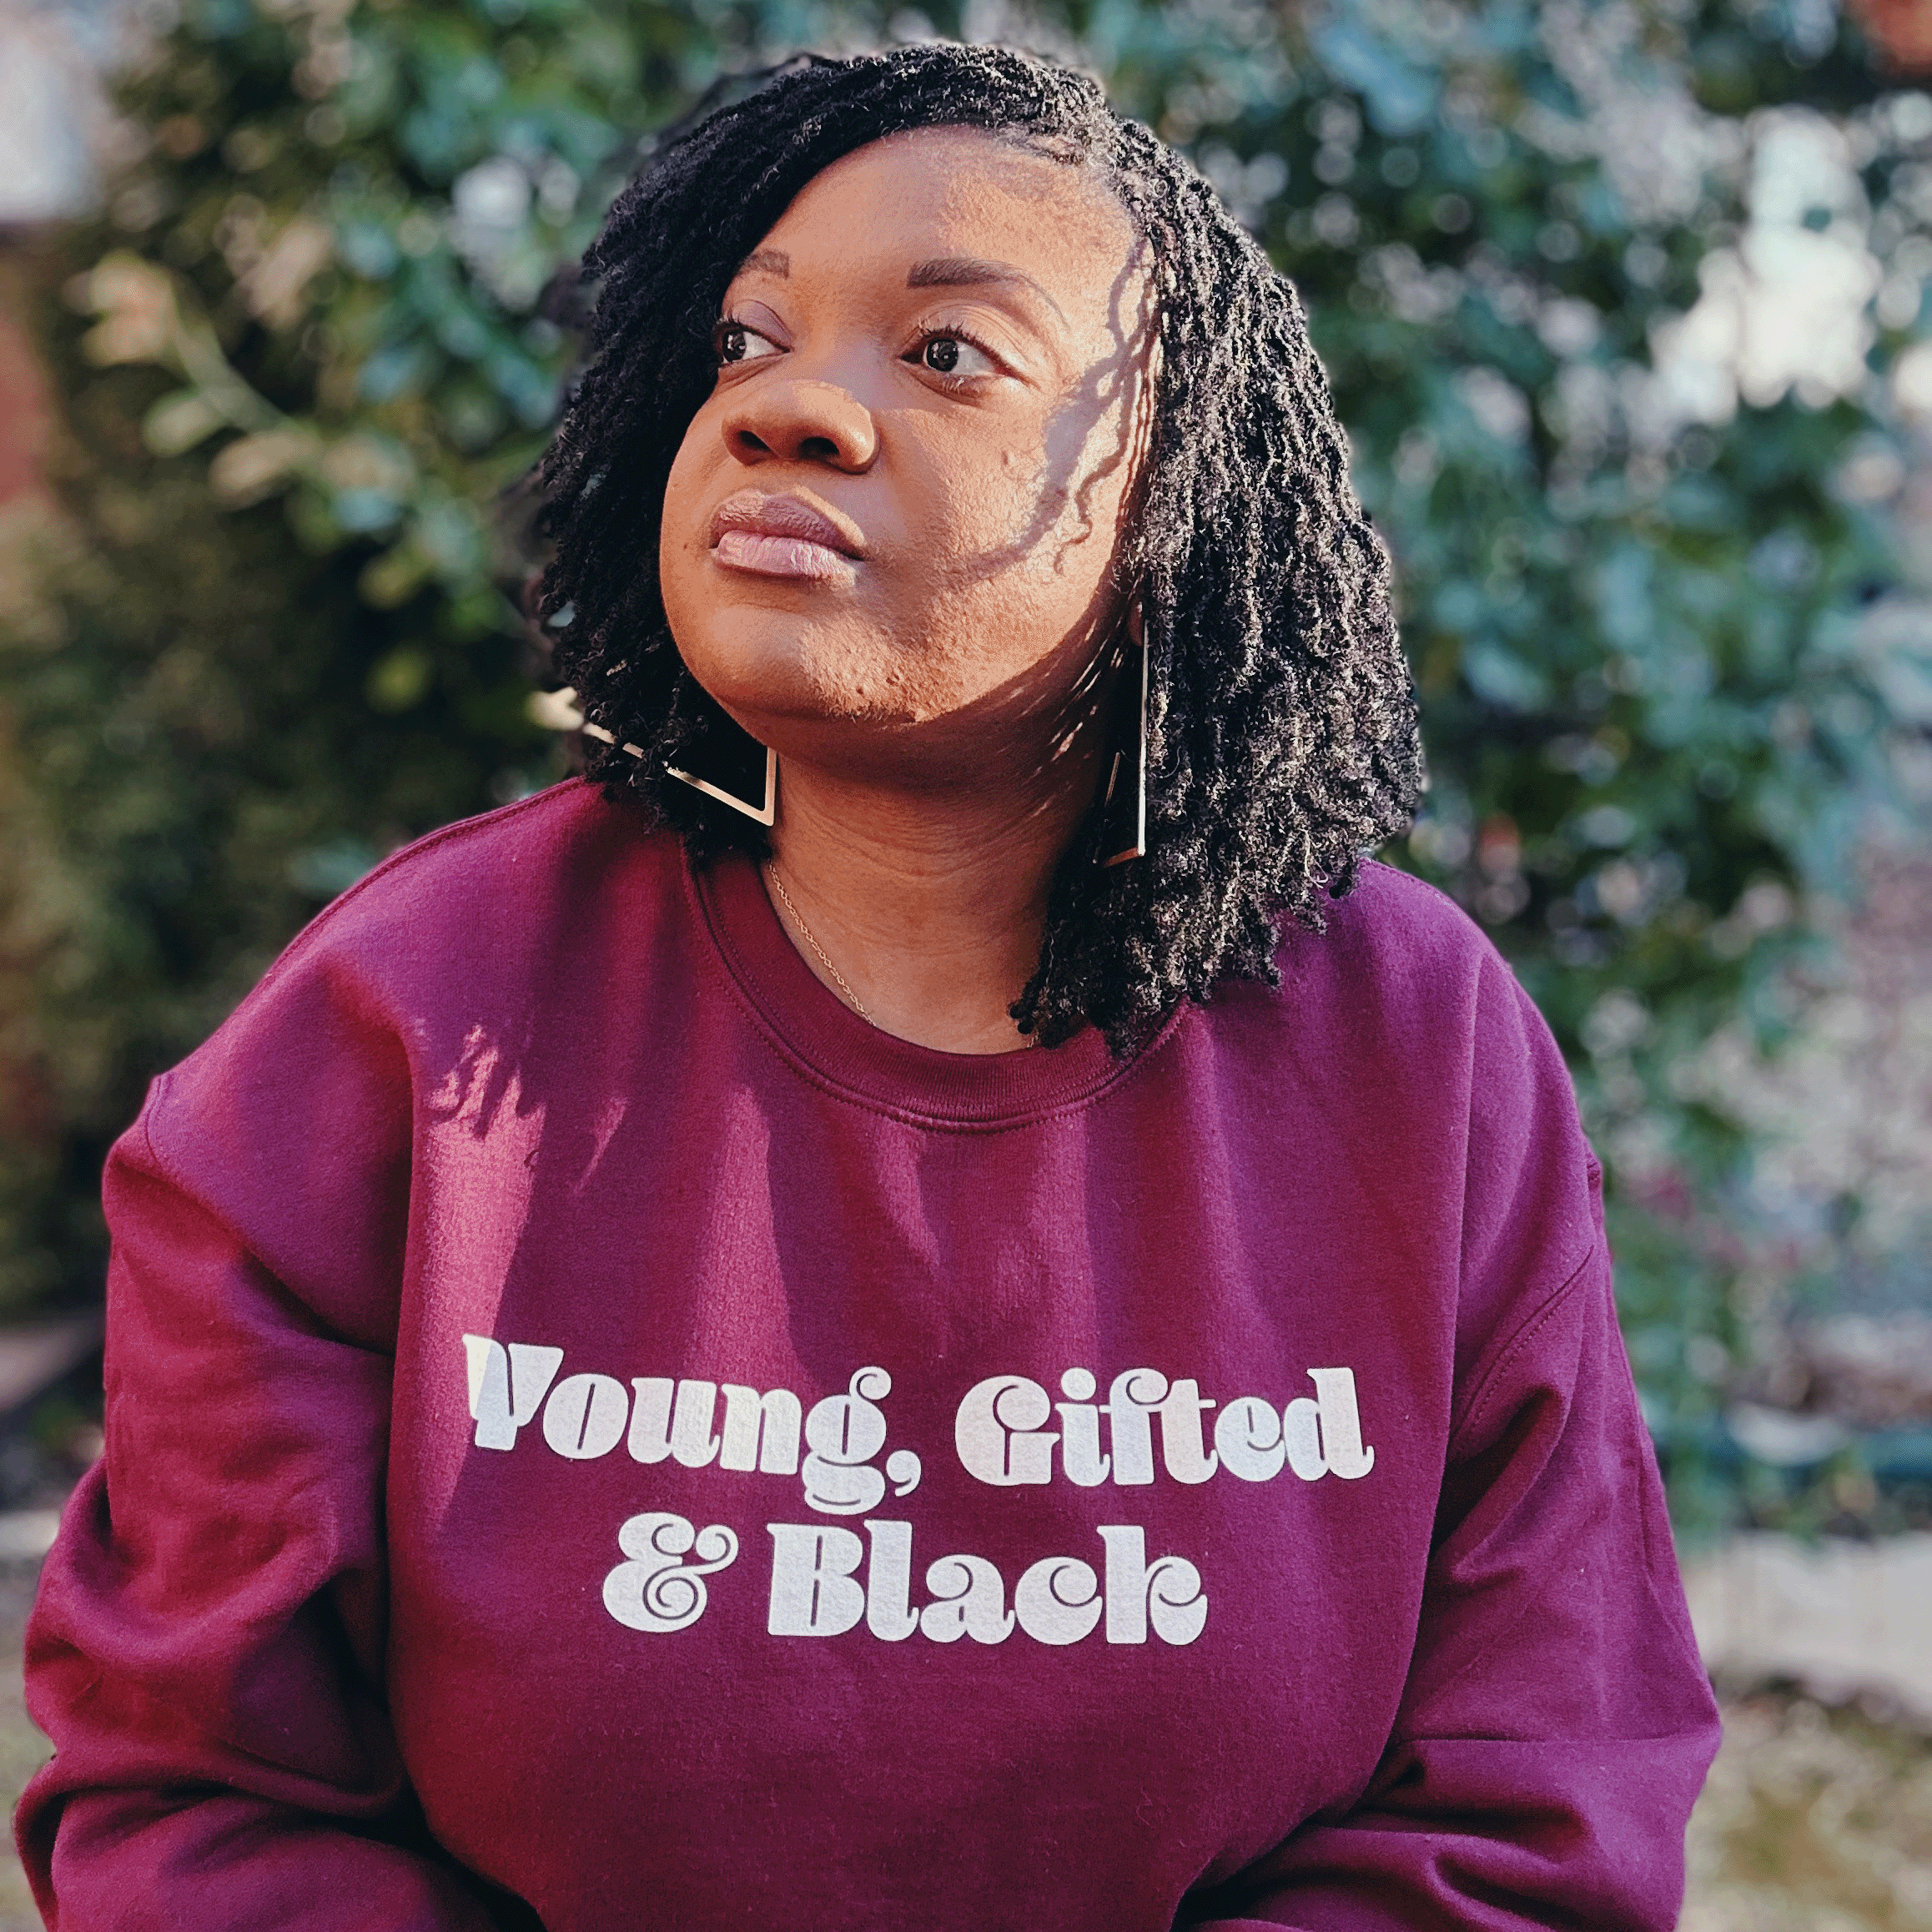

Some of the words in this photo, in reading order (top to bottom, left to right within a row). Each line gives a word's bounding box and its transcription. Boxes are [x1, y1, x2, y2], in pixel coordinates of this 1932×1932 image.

[461, 1333, 922, 1516] Young,
[954, 1366, 1375, 1487] Gifted
[601, 1512, 739, 1634] &
[766, 1519, 1208, 1646] Black
